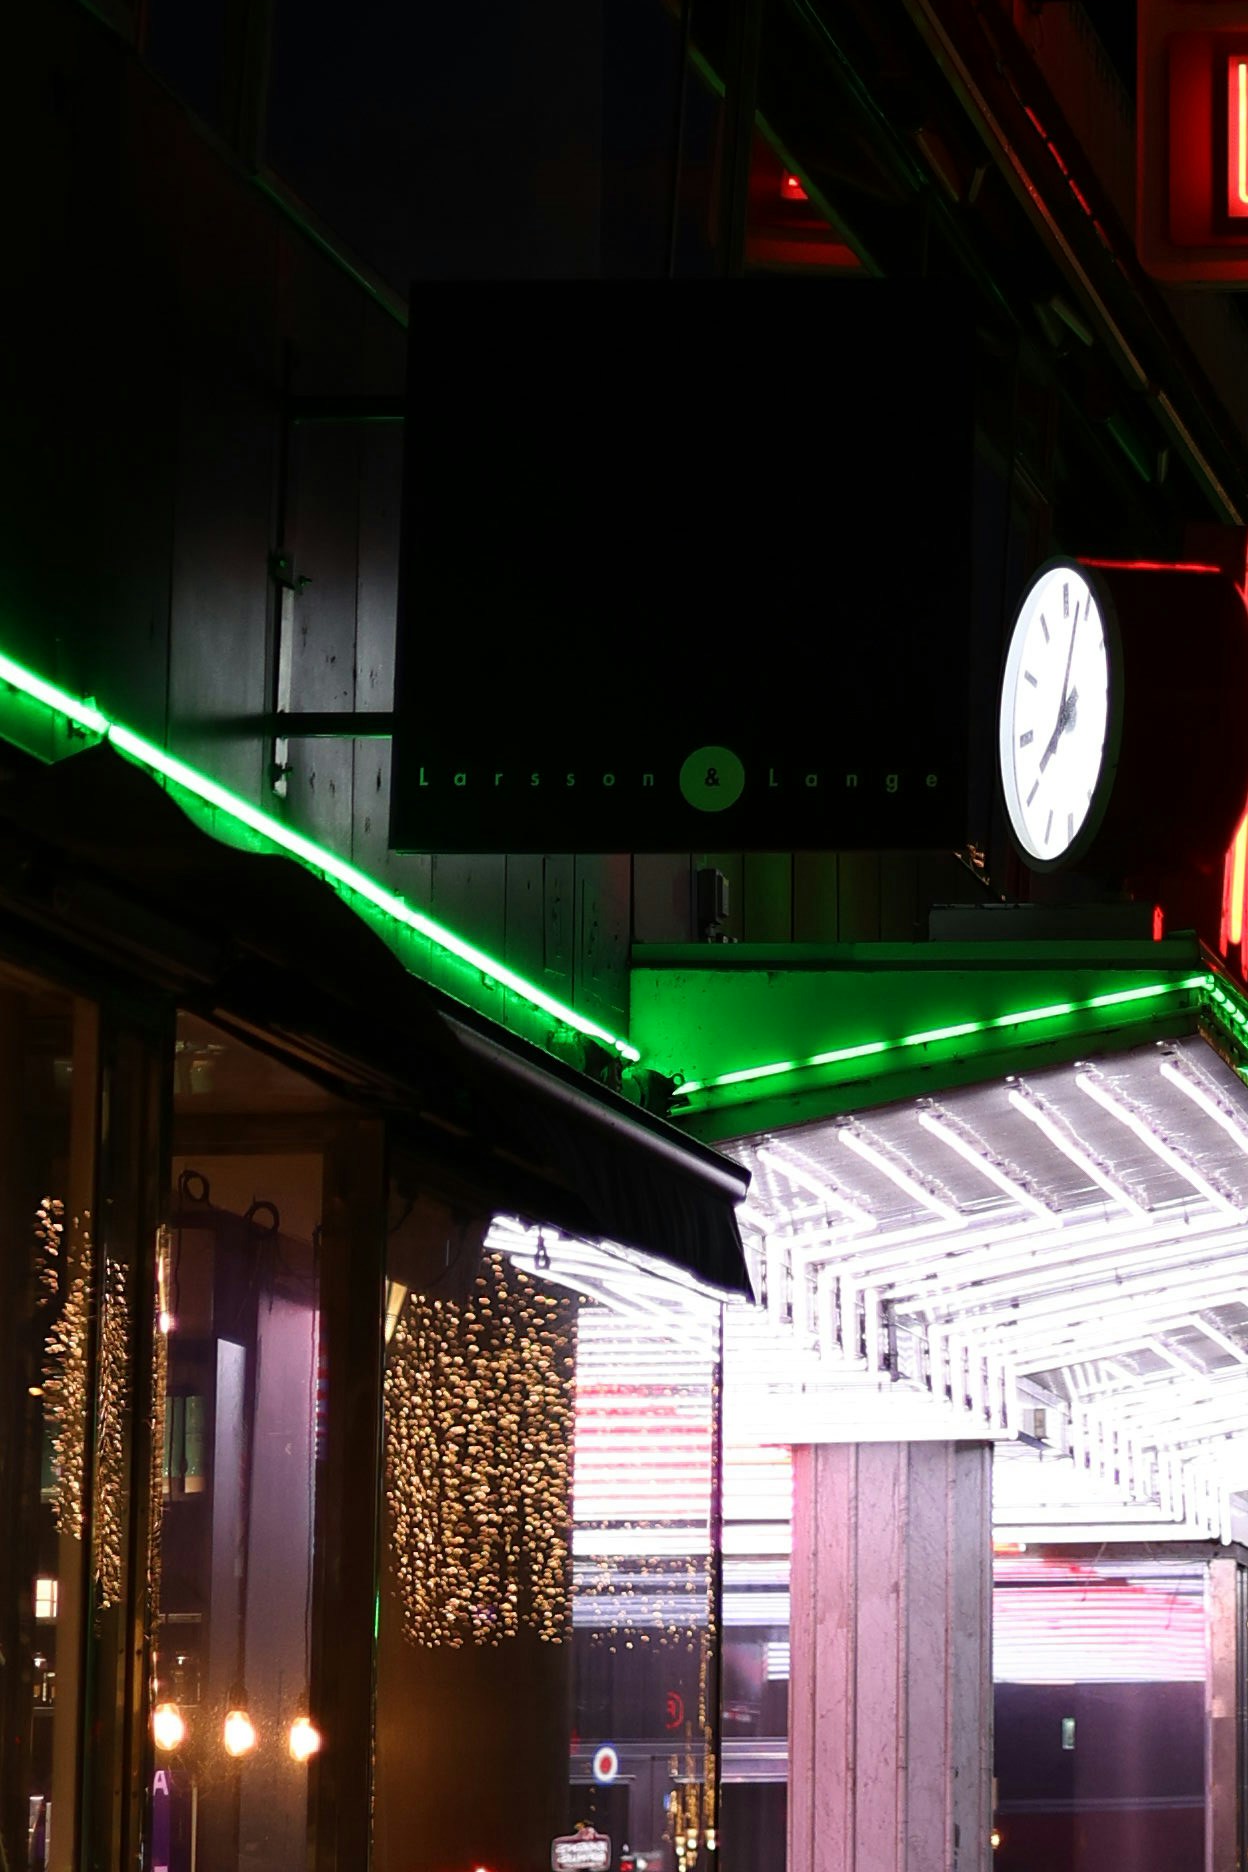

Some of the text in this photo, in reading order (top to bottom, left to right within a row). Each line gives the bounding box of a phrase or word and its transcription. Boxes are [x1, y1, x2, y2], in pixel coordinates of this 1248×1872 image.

[417, 766, 938, 794] Larsson & Lange
